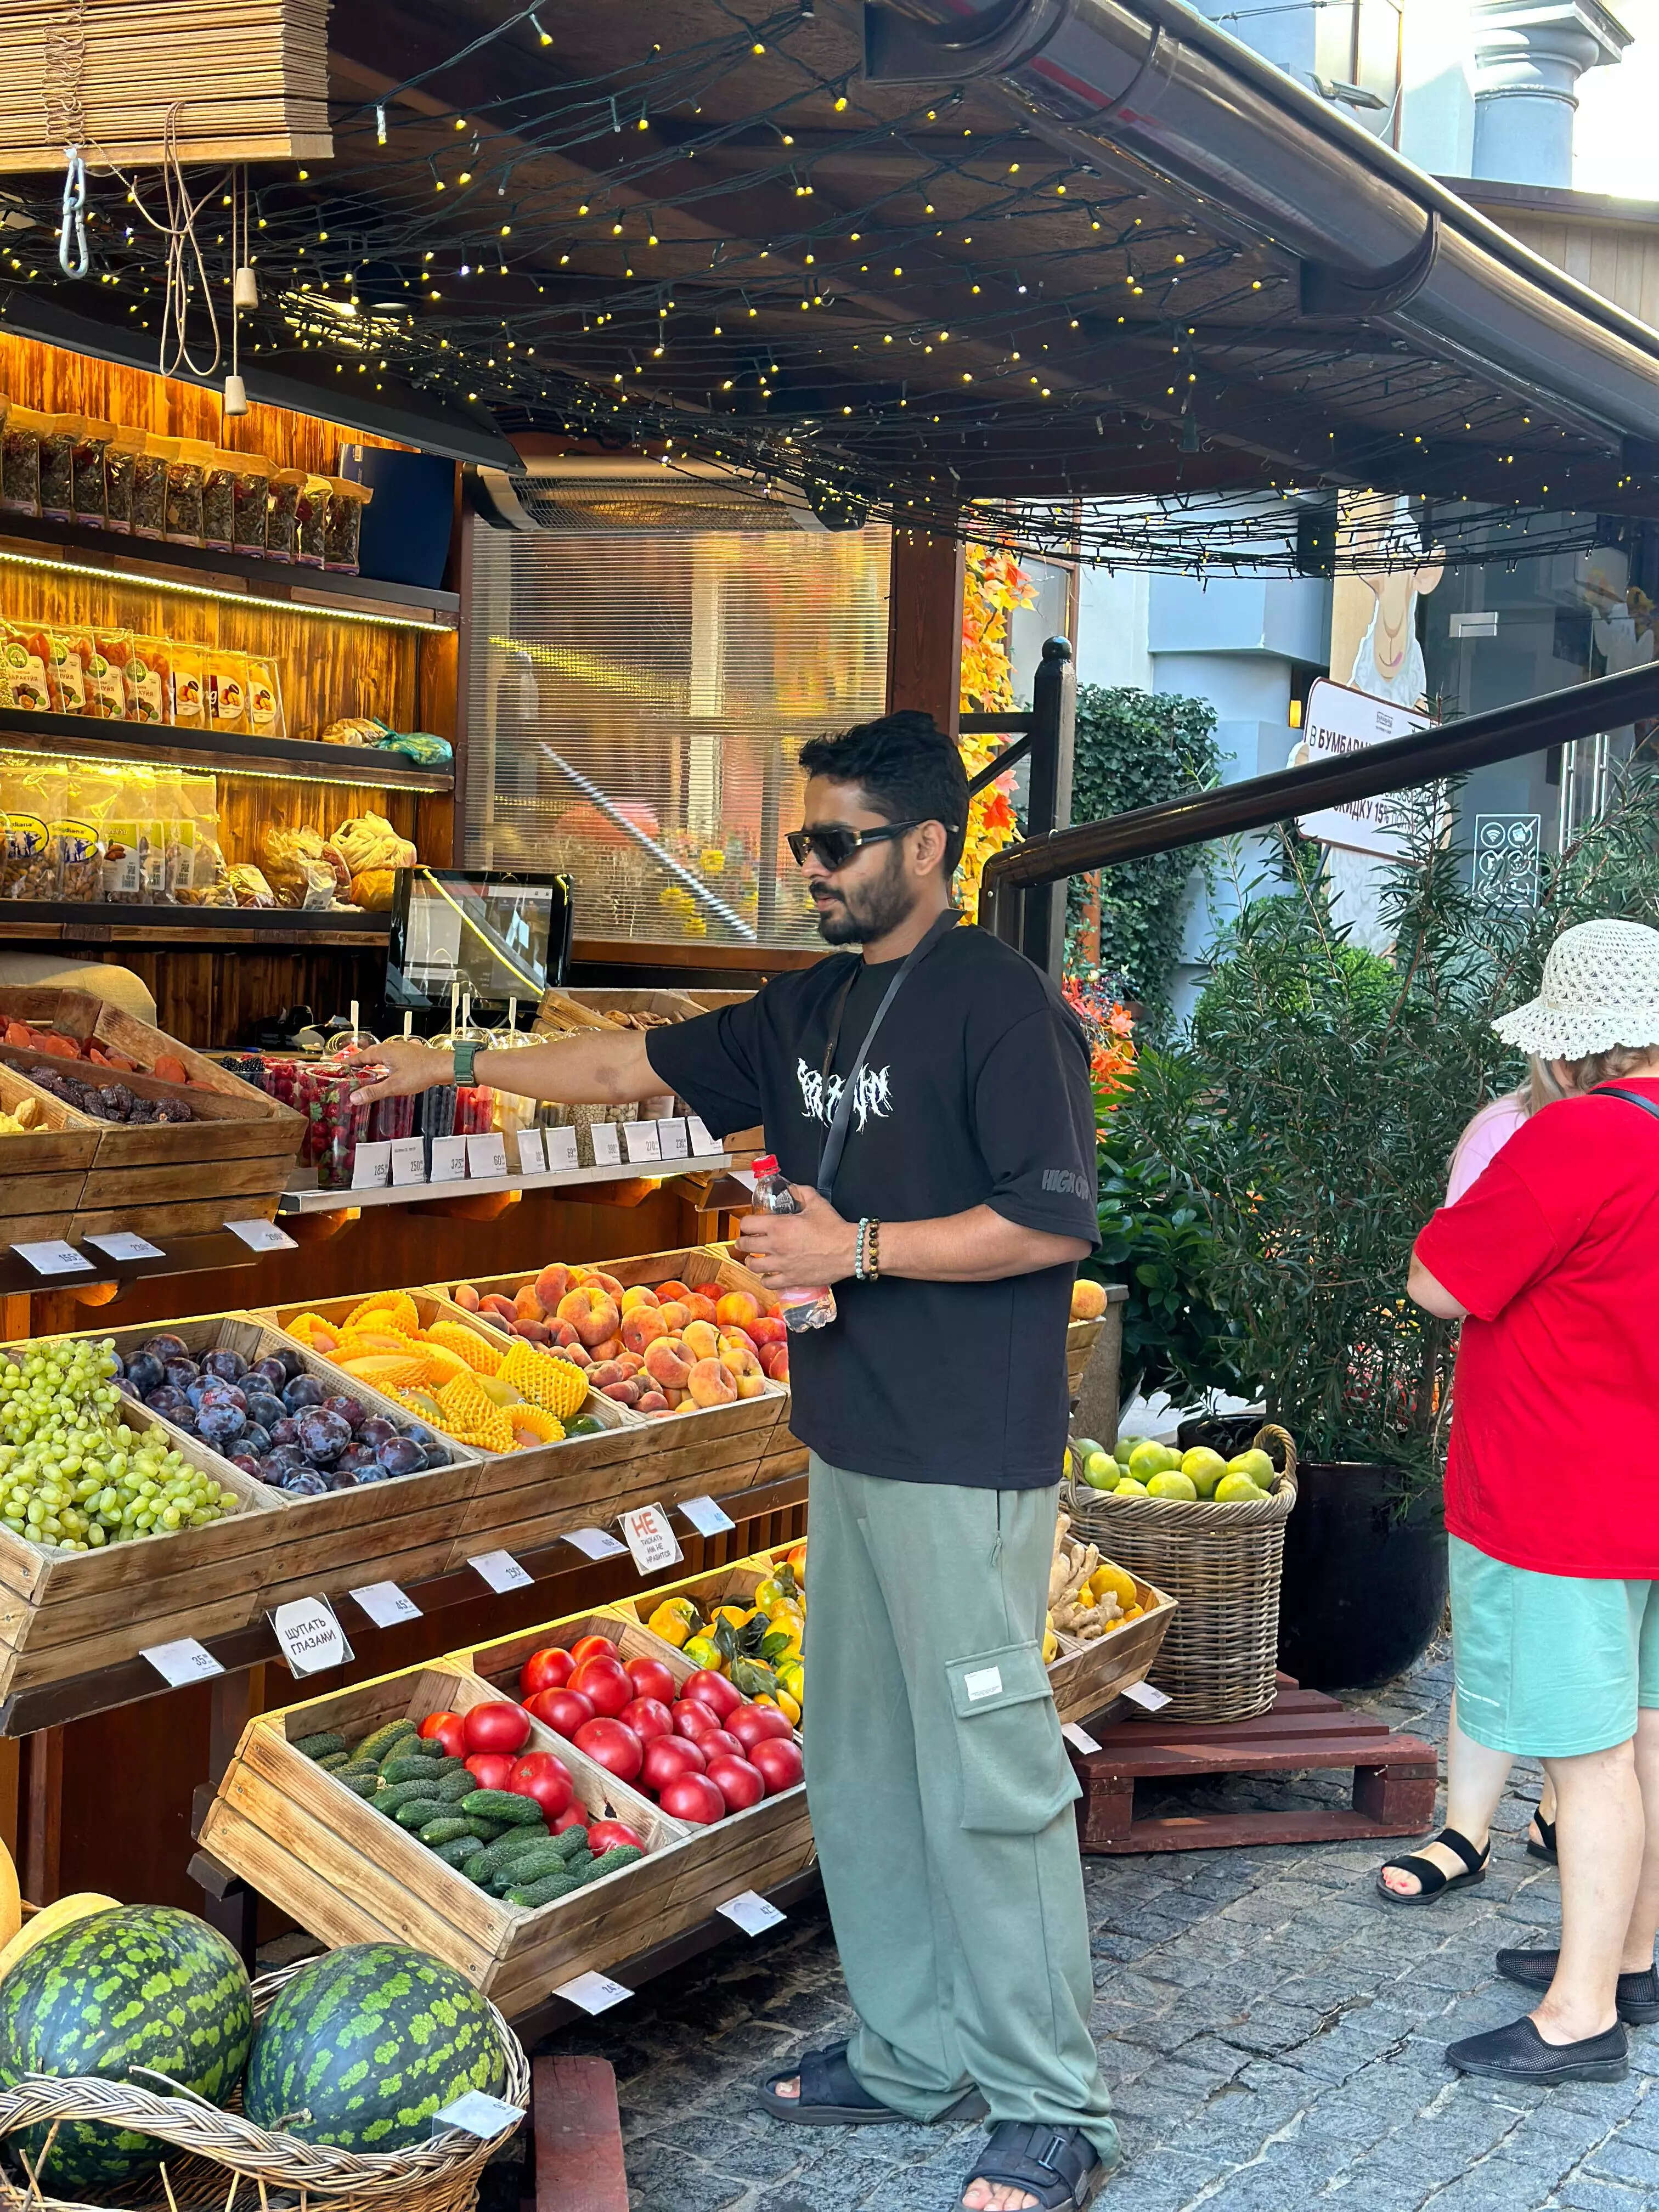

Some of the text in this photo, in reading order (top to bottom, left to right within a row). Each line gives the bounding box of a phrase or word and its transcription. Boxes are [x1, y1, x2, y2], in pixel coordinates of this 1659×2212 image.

[1310, 725, 1317, 746] В
[410, 1161, 420, 1172] 250
[631, 1511, 658, 1538] НЕ
[641, 1534, 663, 1545] ТИСКАТЬ
[646, 1550, 671, 1564] НРАВИТСЯ
[396, 1600, 408, 1610] 45
[285, 1618, 326, 1640] ЩУПАТЬ
[291, 1629, 336, 1655] ГЛАЗАМИ
[192, 1655, 207, 1666] 35
